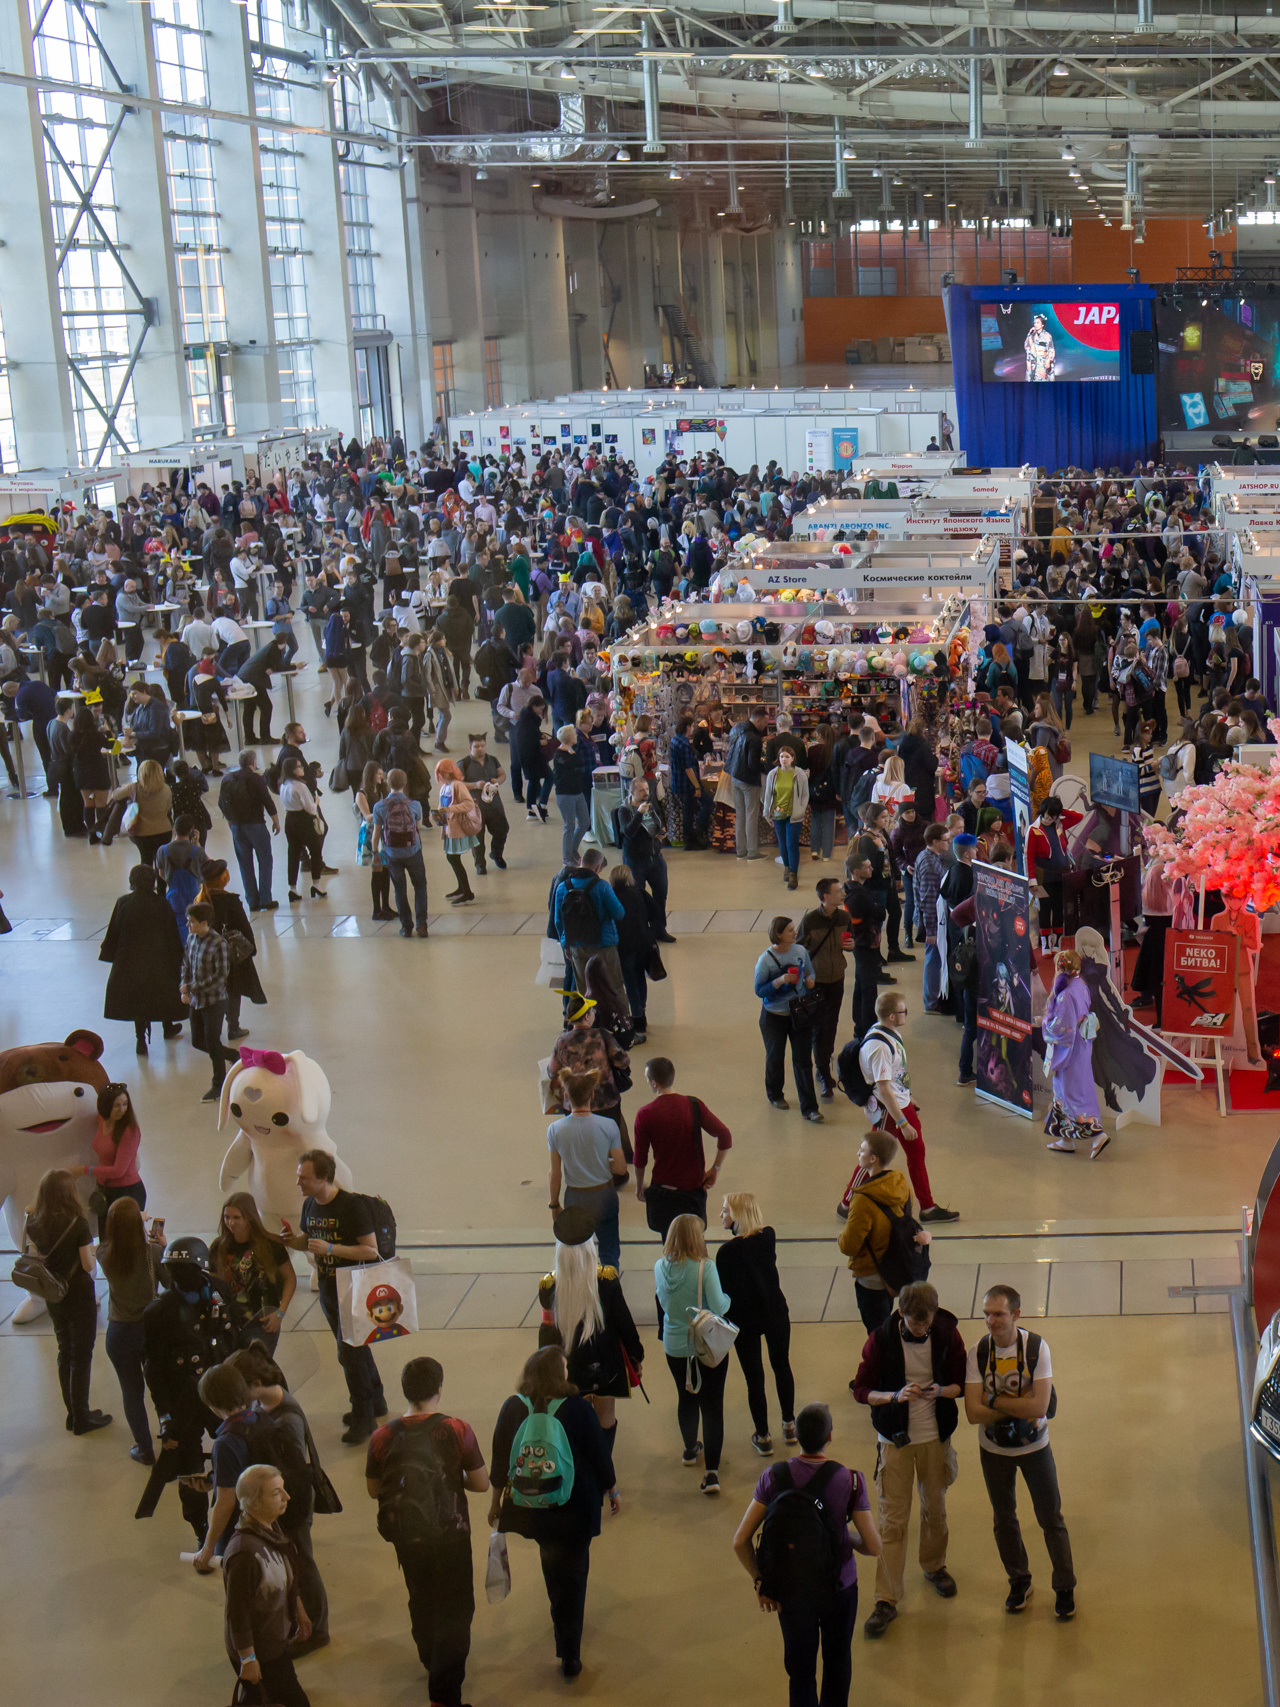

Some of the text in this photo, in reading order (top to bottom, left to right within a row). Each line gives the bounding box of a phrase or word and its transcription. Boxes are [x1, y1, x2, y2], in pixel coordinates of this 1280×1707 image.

[972, 486, 999, 494] Samedy
[906, 516, 1011, 525] Институт Японского Языка
[783, 575, 807, 583] Store
[863, 572, 972, 582] Космические коктейли
[1186, 948, 1216, 958] NEKO
[1180, 957, 1220, 968] БИТВА!
